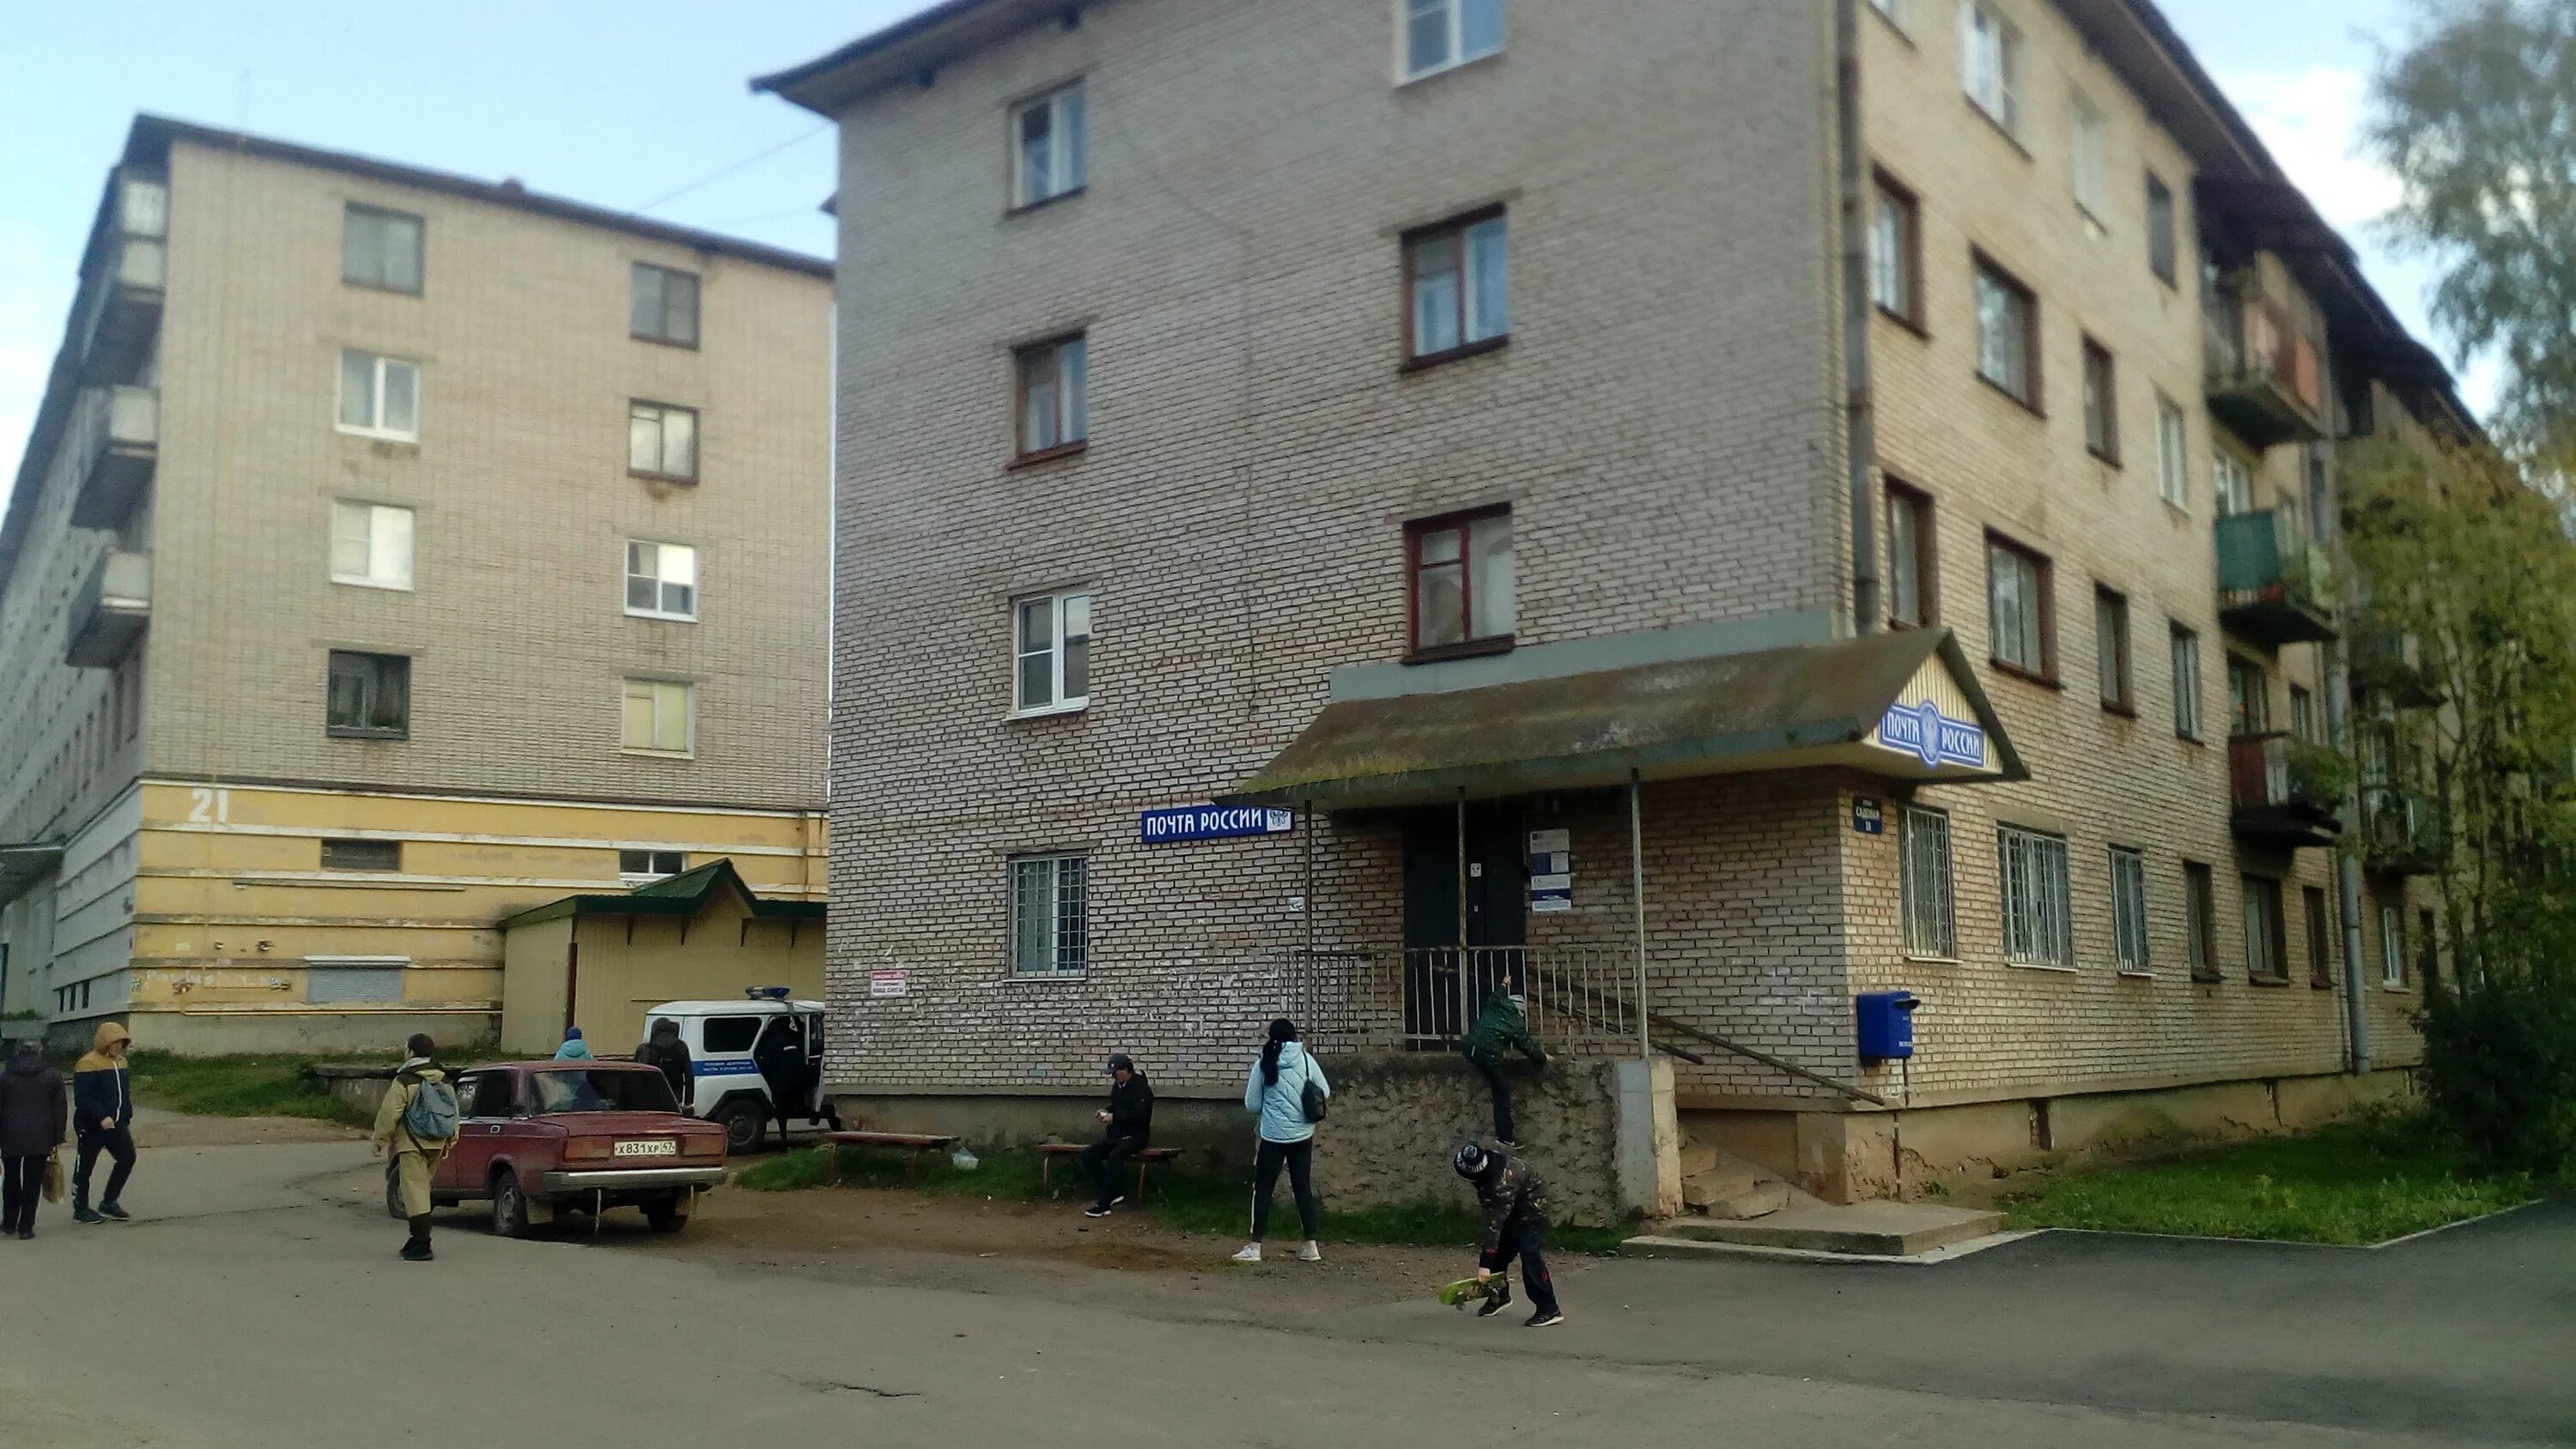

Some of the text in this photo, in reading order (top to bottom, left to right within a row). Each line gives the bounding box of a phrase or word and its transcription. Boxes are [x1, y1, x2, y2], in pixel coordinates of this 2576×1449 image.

[1887, 712, 1980, 757] ПОЧТА РОССИИ
[189, 788, 228, 823] 21
[1146, 809, 1262, 836] ПОЧТА РОССИИ
[662, 1142, 672, 1150] 47
